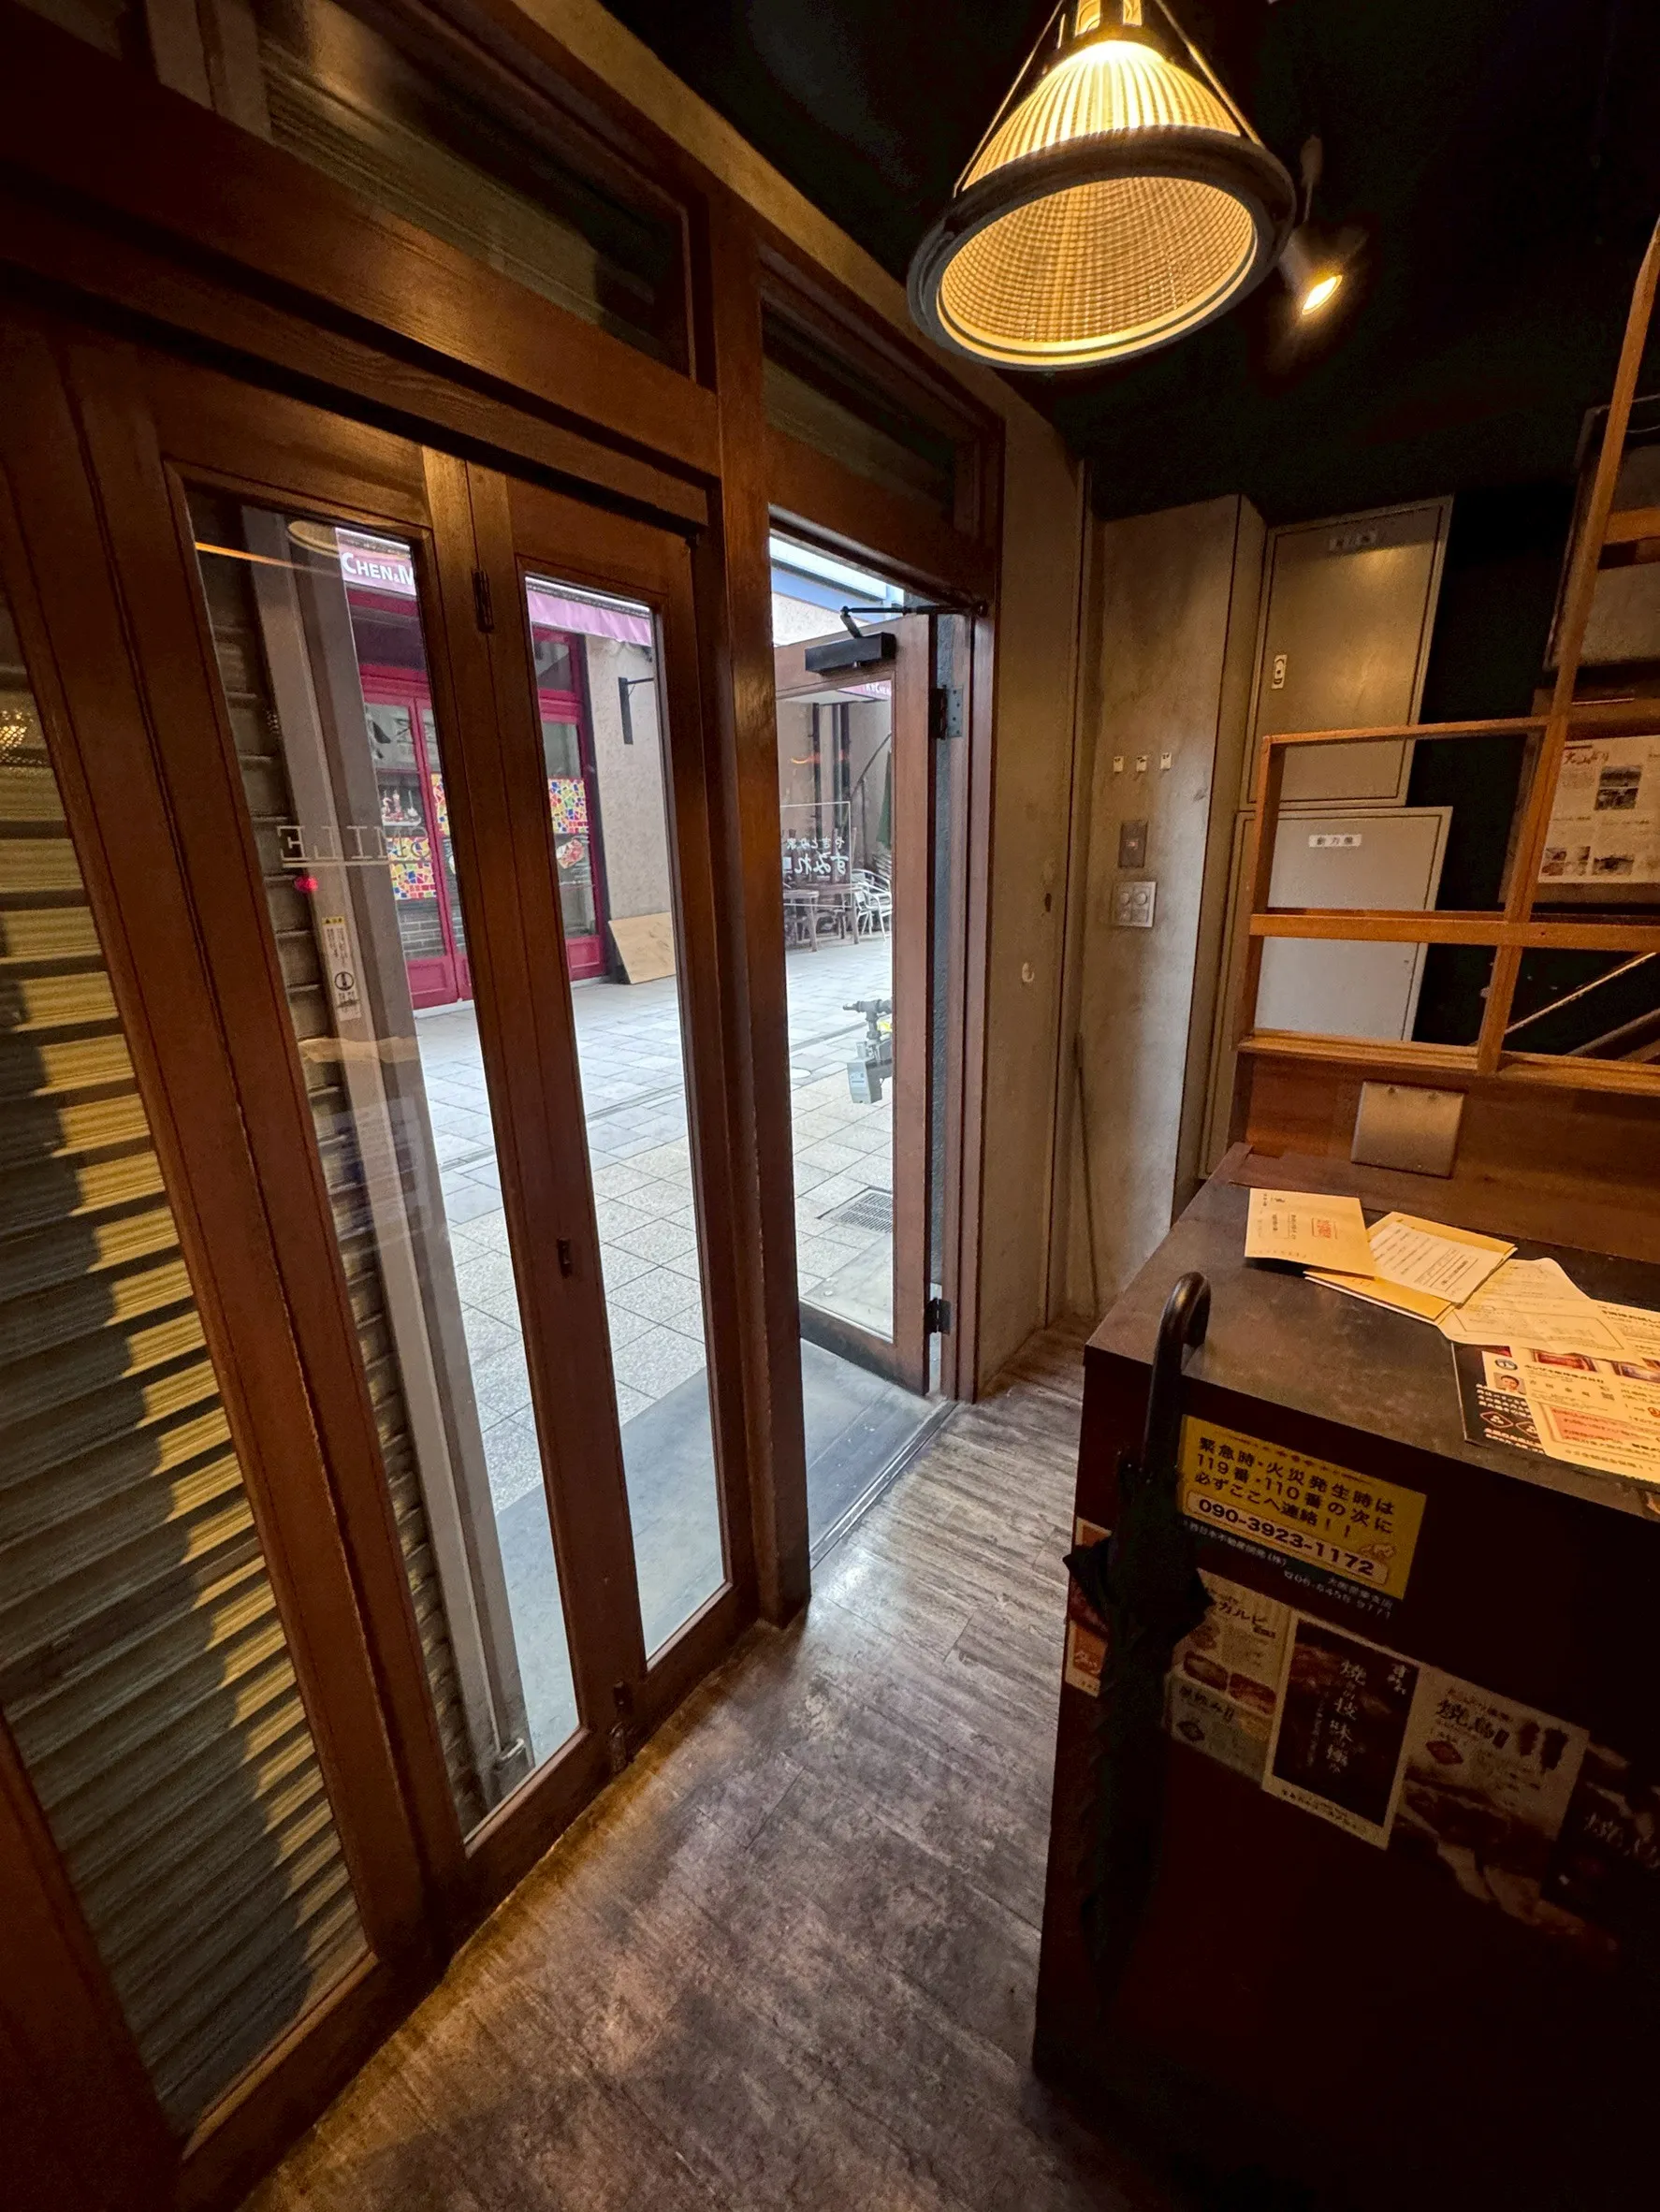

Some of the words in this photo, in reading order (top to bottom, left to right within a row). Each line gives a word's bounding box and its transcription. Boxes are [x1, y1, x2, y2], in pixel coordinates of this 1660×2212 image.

[1199, 1437, 1394, 1516] 緊急時・火災発生時は
[1198, 1498, 1375, 1577] 090-3923-1172
